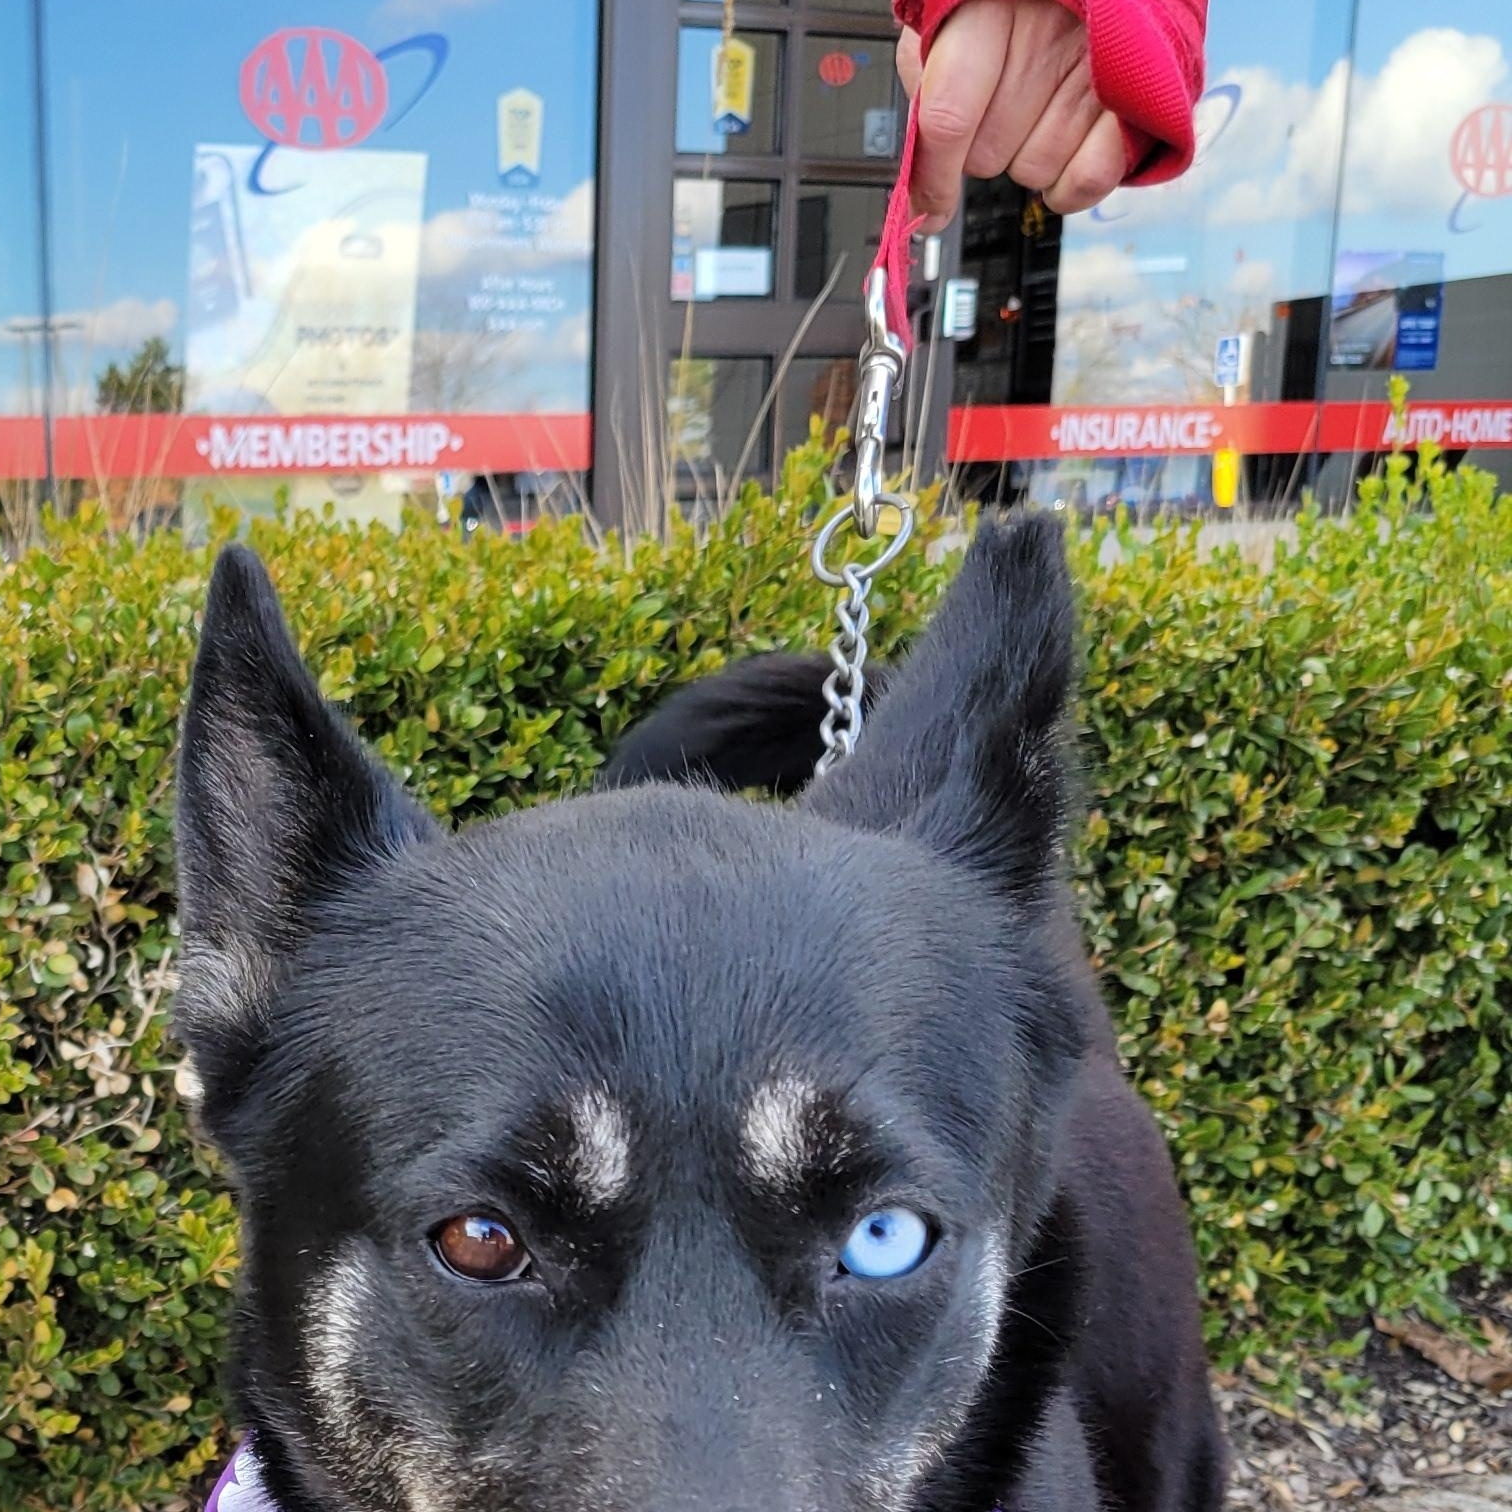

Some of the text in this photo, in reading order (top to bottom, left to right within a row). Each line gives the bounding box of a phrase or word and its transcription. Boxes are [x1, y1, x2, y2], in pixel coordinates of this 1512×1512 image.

[240, 27, 387, 150] AAA
[1450, 104, 1512, 196] AA
[208, 422, 451, 469] MEMBERSHIP
[1059, 410, 1216, 451] INSURANCE
